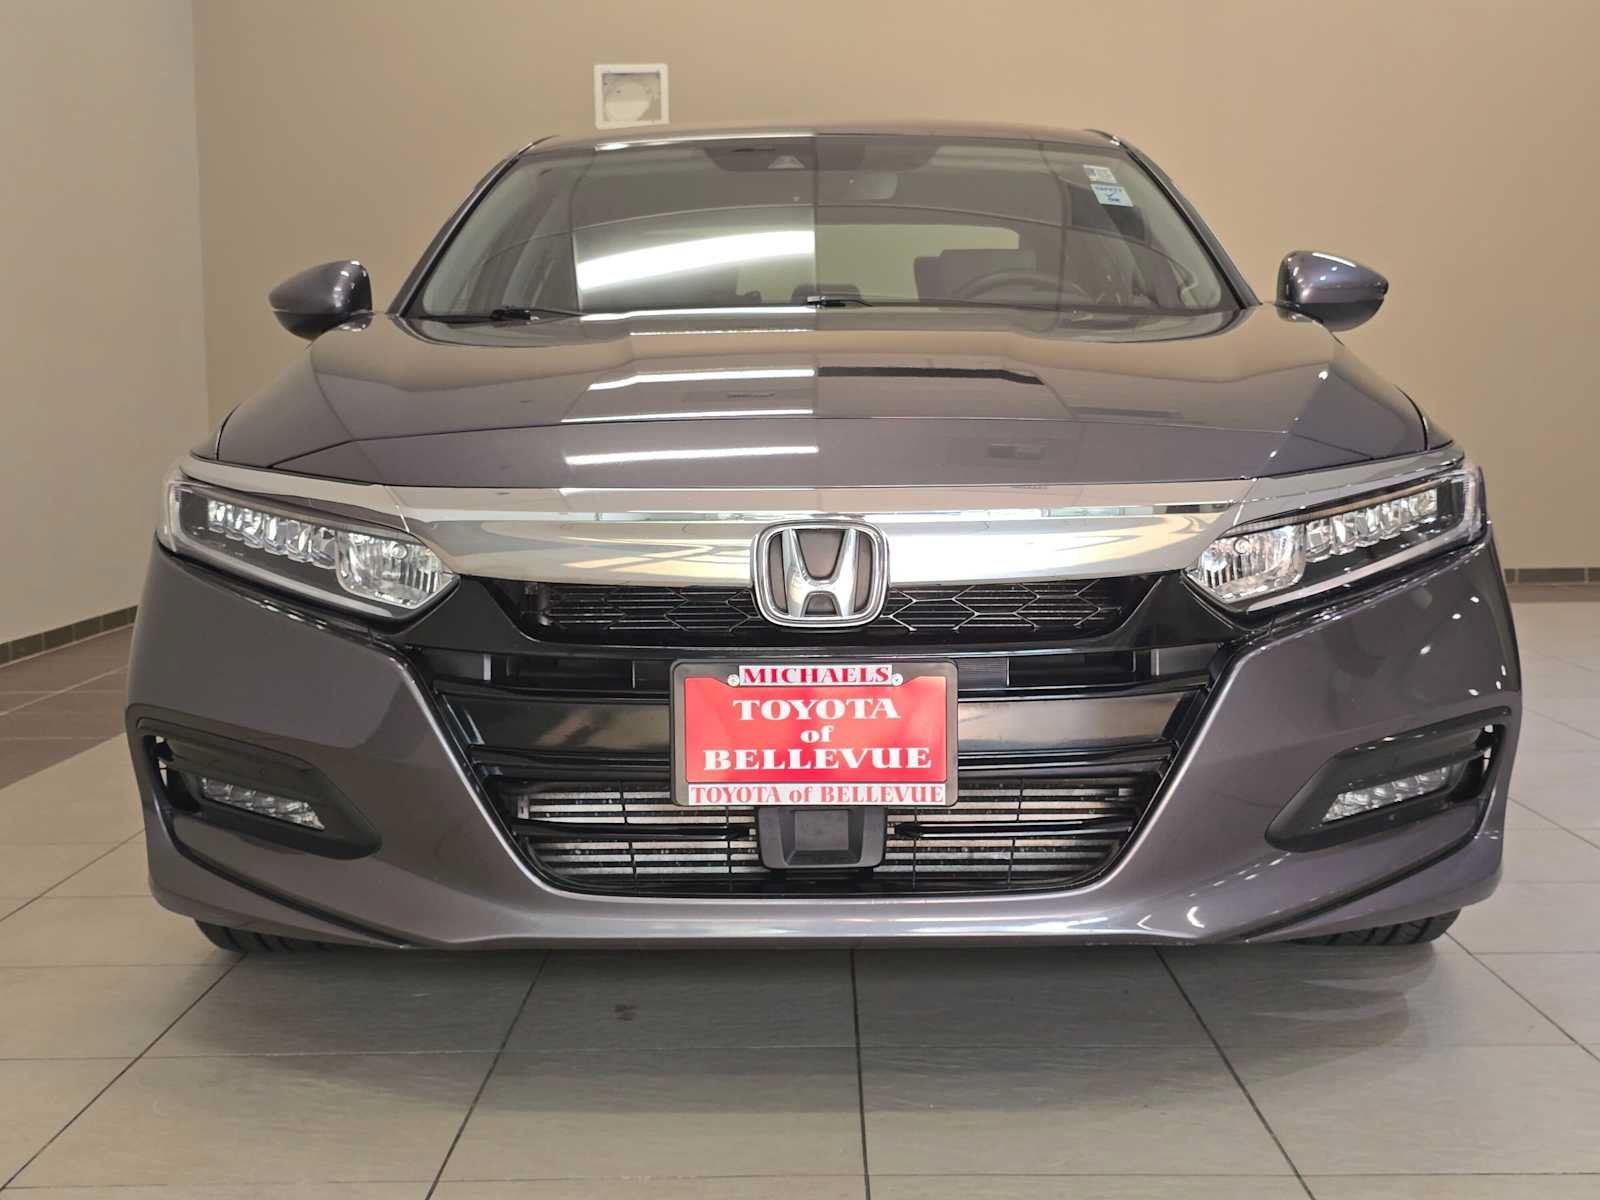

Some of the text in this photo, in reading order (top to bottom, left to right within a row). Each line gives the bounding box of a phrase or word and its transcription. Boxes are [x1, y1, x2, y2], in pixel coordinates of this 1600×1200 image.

[743, 667, 890, 683] MICHAELS
[733, 699, 900, 720] TOYOTA
[800, 725, 835, 743] of
[703, 748, 932, 770] BELLEVUE
[691, 785, 945, 804] TOYOTA of BELLEVUE
